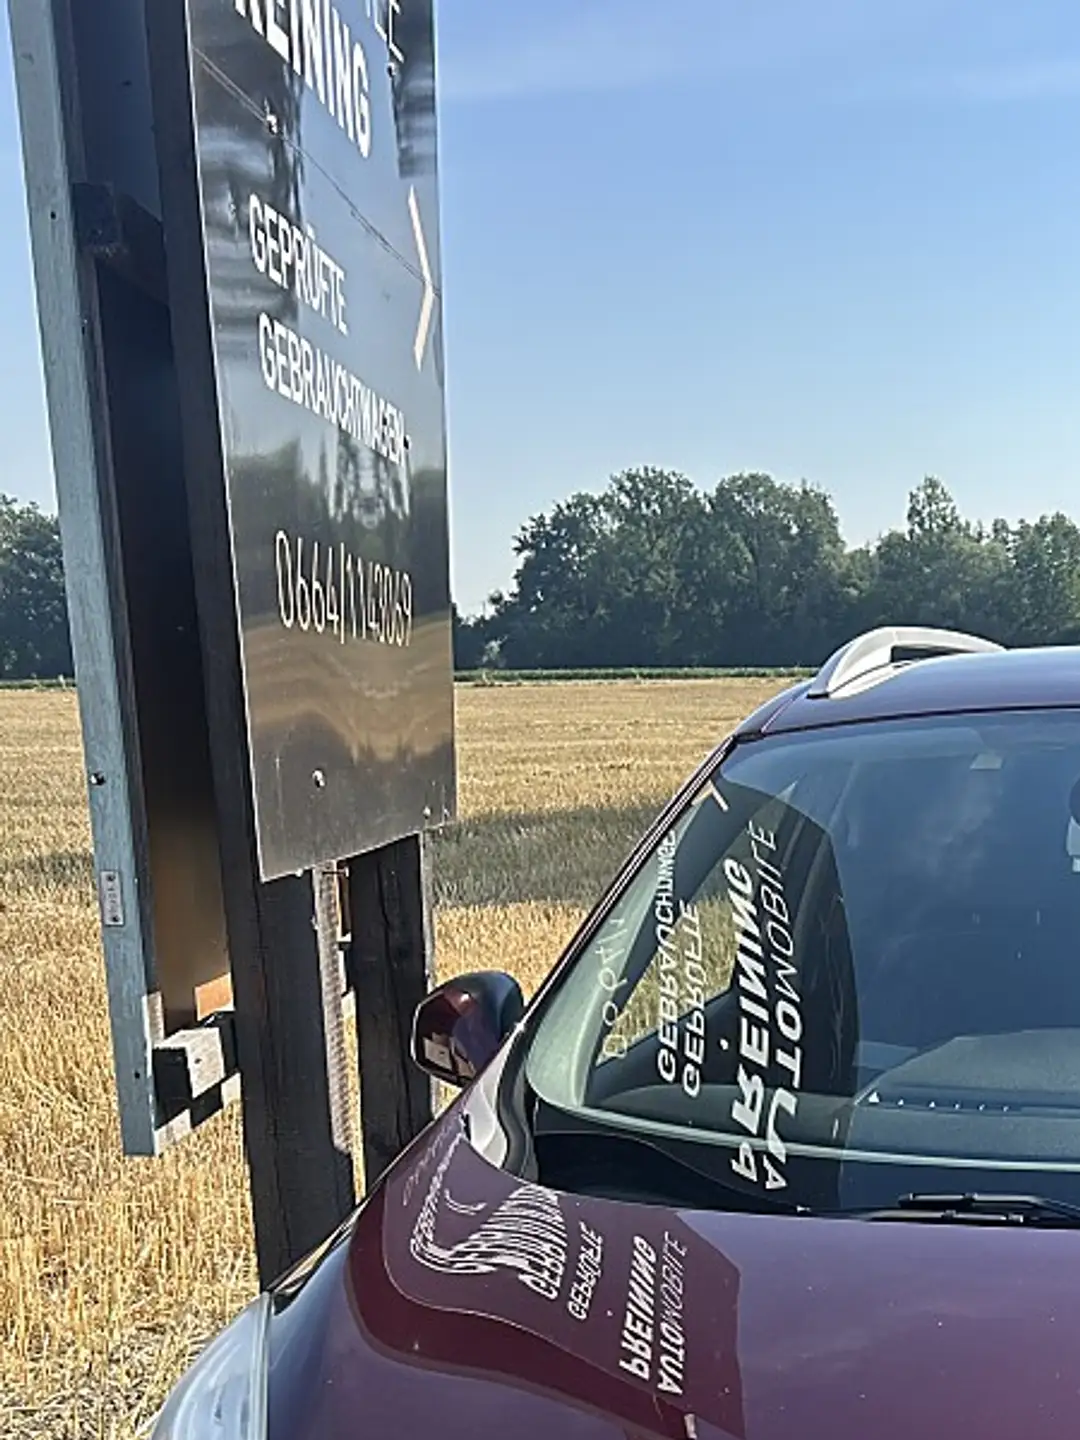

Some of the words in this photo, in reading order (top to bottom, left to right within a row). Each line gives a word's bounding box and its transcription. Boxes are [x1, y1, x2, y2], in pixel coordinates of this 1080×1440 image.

[235, 0, 372, 158] EINING
[249, 193, 348, 336] GEPRÜFTE
[259, 311, 406, 467] GEBRAUCHTWAGEN
